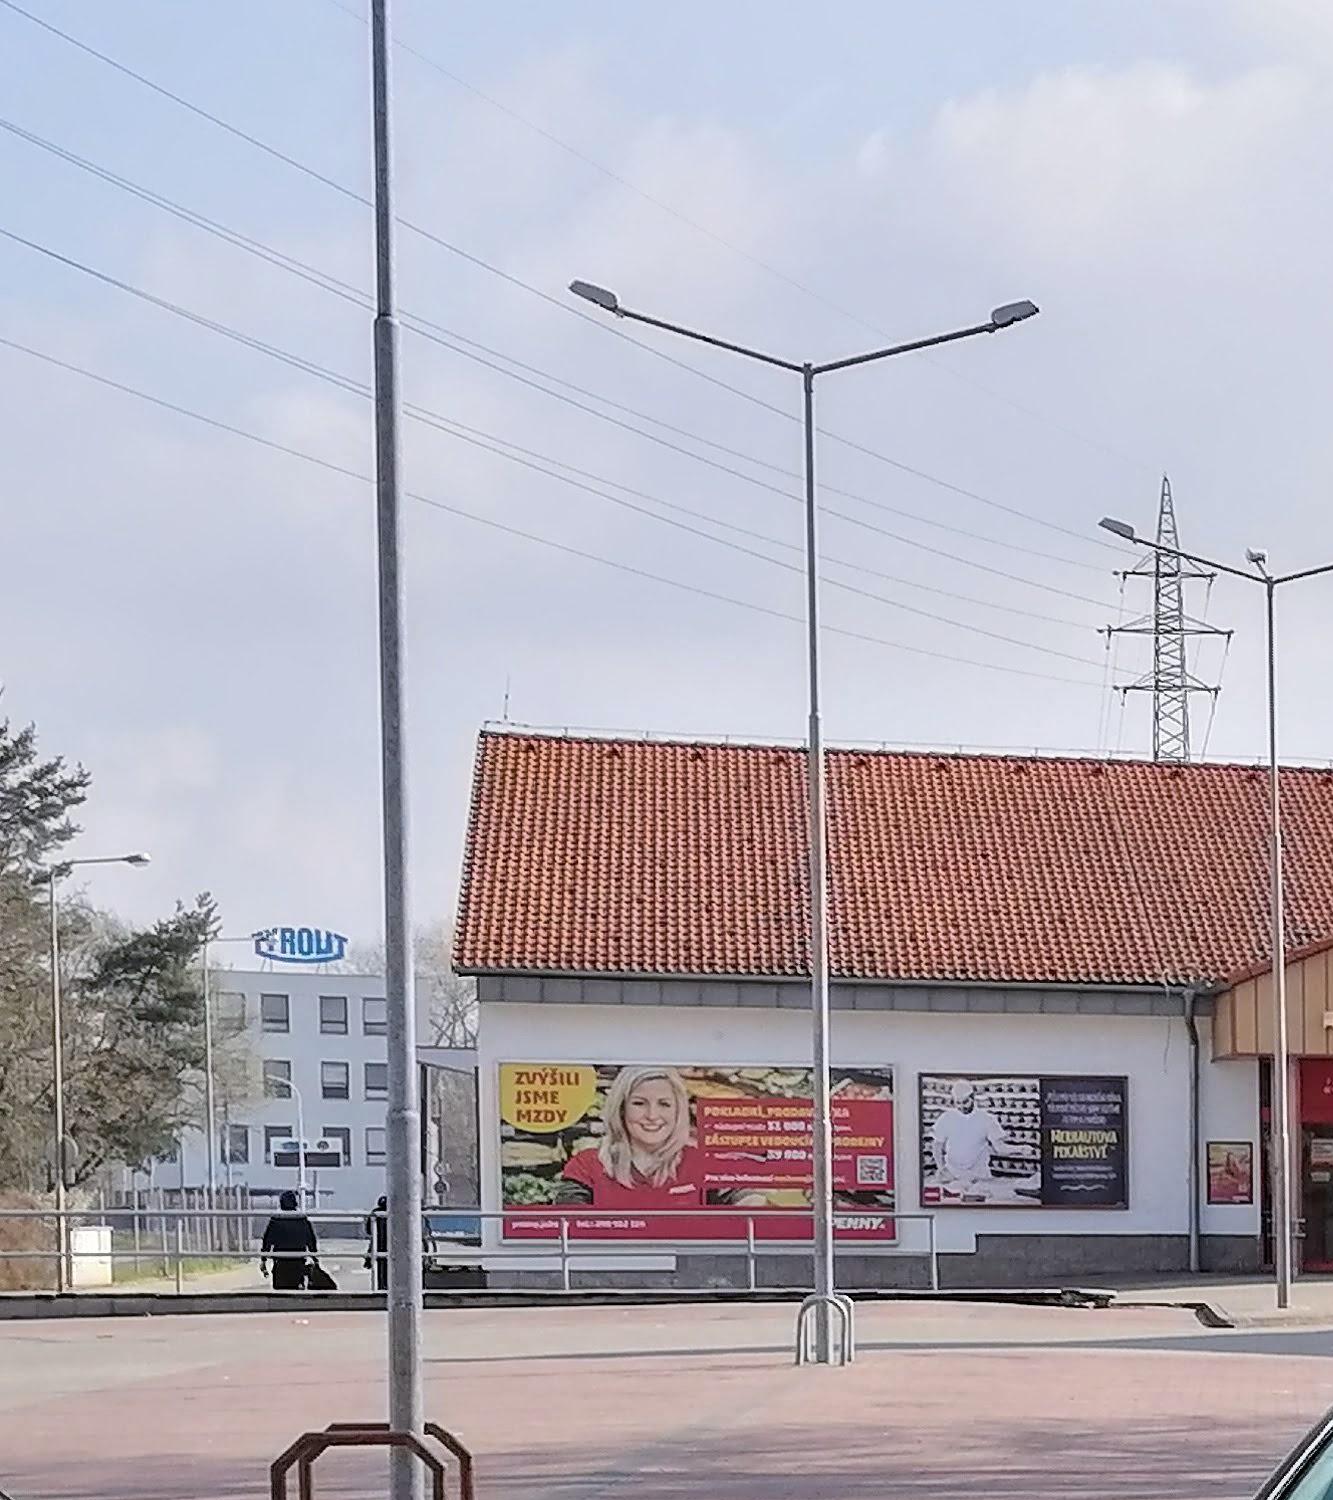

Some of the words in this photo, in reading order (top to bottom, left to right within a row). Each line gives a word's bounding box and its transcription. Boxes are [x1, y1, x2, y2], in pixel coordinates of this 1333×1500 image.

[515, 1067, 580, 1086] ZVÝŠILI
[515, 1090, 560, 1105] JSME
[516, 1109, 567, 1123] MZDY
